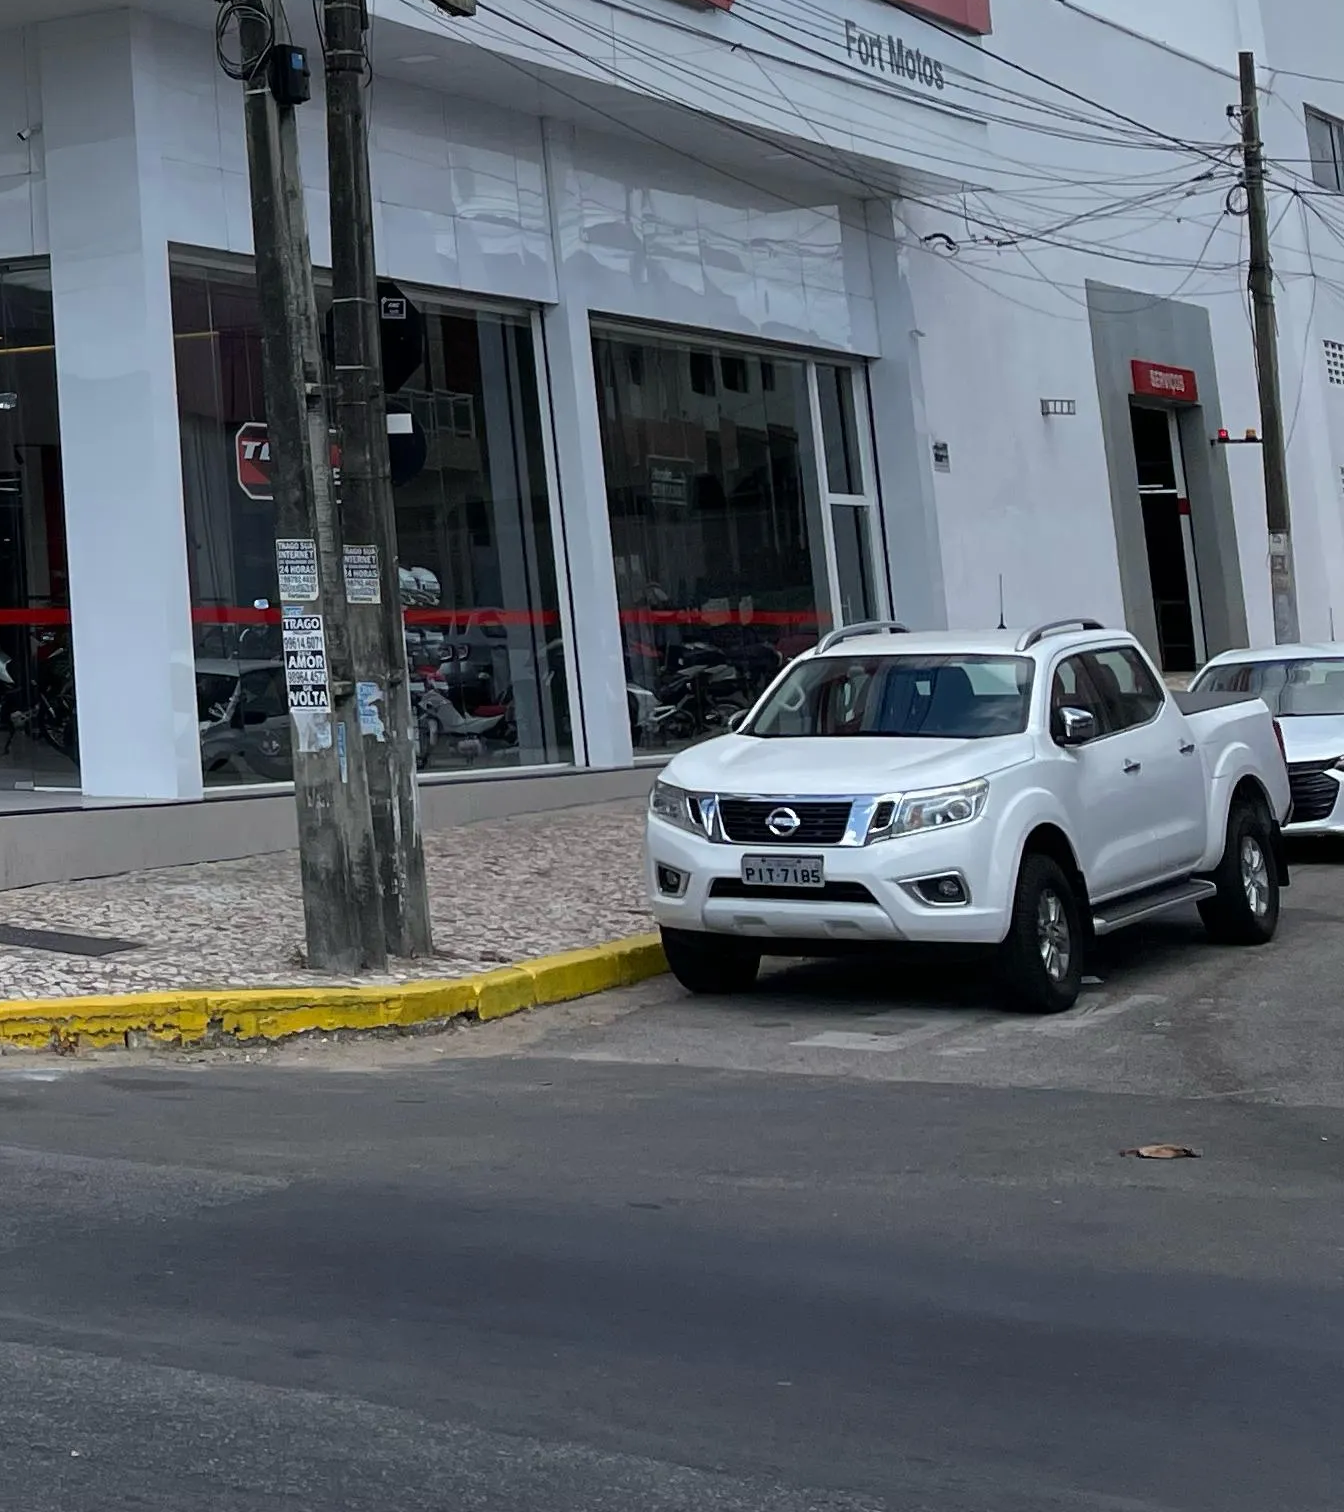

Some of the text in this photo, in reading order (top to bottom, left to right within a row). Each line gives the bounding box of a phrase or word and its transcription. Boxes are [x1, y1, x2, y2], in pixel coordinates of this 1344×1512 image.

[844, 18, 944, 90] Fort Motos
[344, 555, 376, 564] NTERNET
[279, 565, 315, 574] 24 HORAS
[283, 618, 320, 630] TRAGO
[288, 655, 324, 669] AMOR
[290, 690, 328, 706] VOLTA
